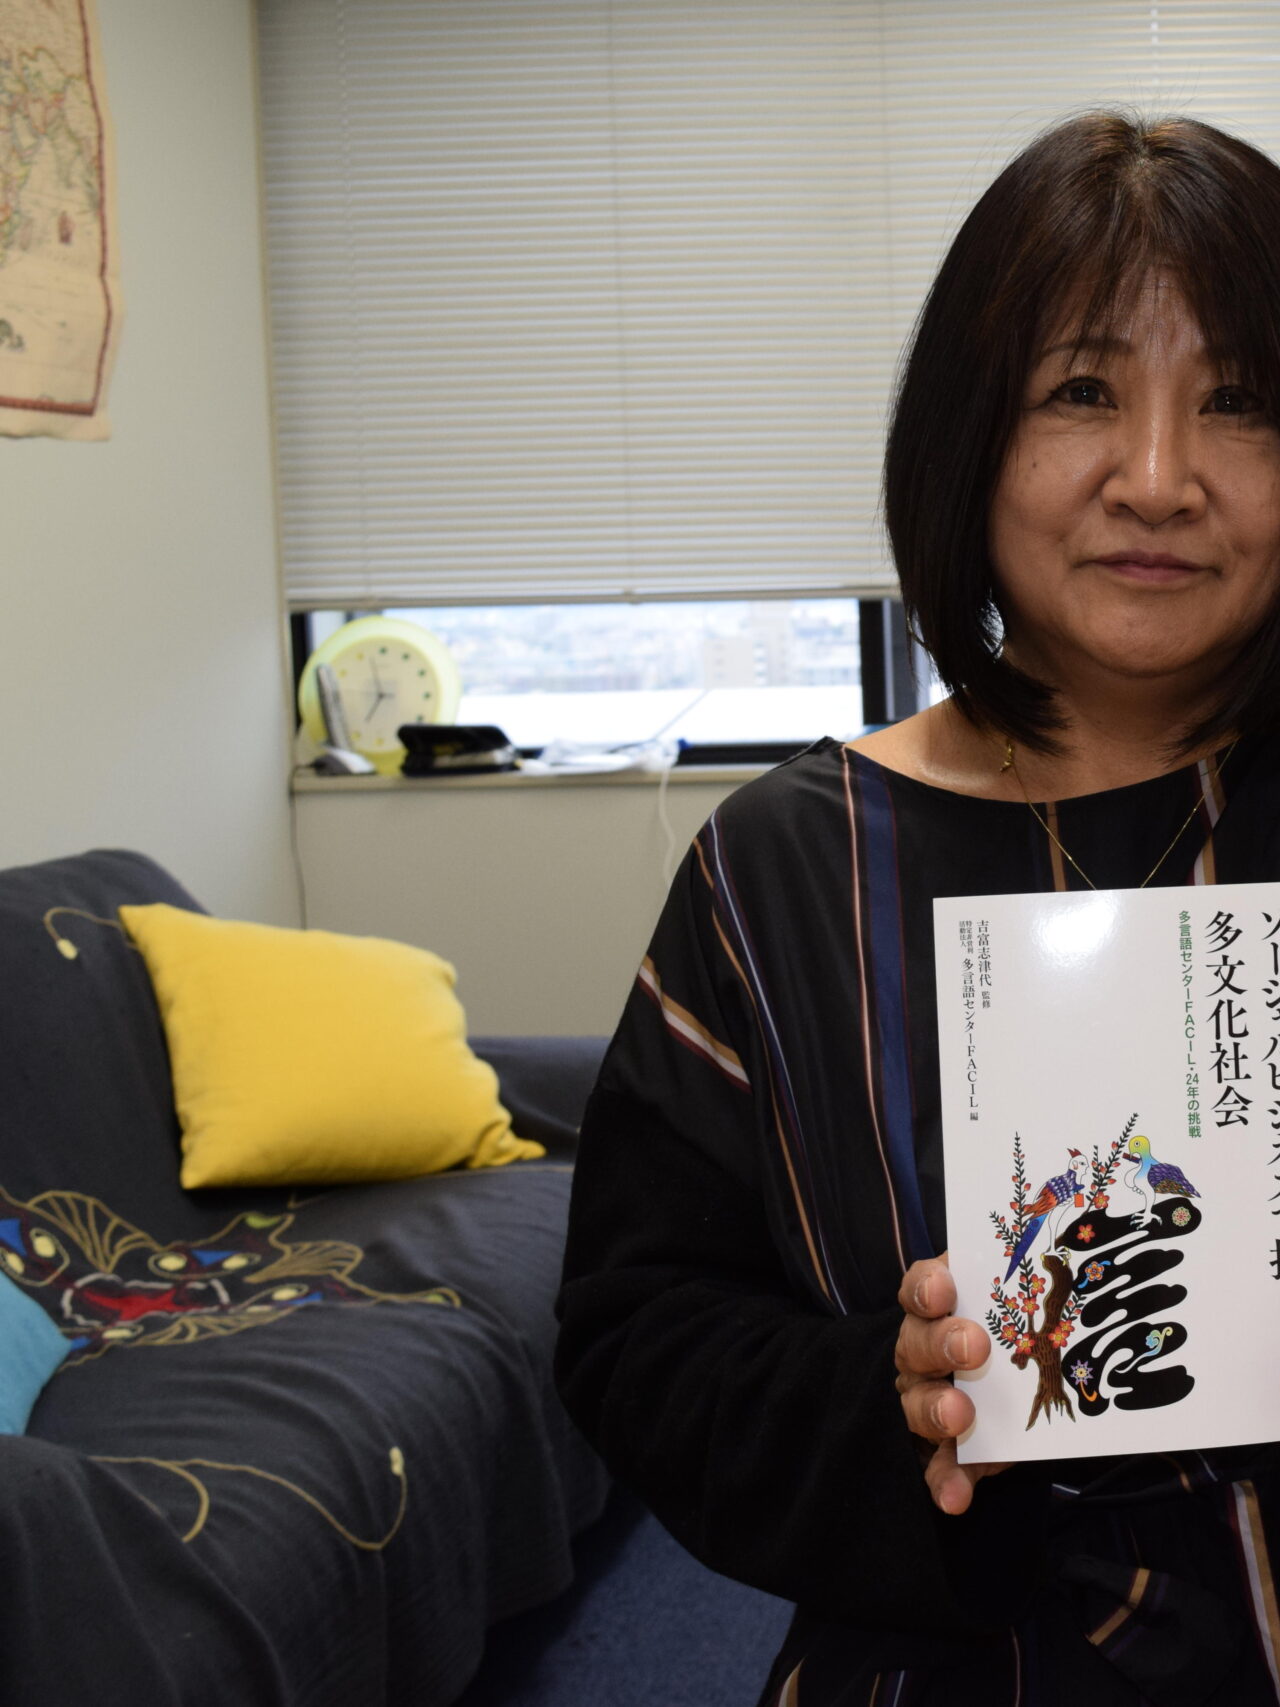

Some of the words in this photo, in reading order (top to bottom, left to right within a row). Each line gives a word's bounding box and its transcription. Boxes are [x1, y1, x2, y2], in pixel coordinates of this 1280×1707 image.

[977, 919, 992, 987] 吉富志津代
[962, 958, 979, 1108] 多言語センターFACIL
[981, 990, 991, 1009] 監修
[1204, 910, 1253, 1128] 多文化社会
[969, 1112, 979, 1121] 編
